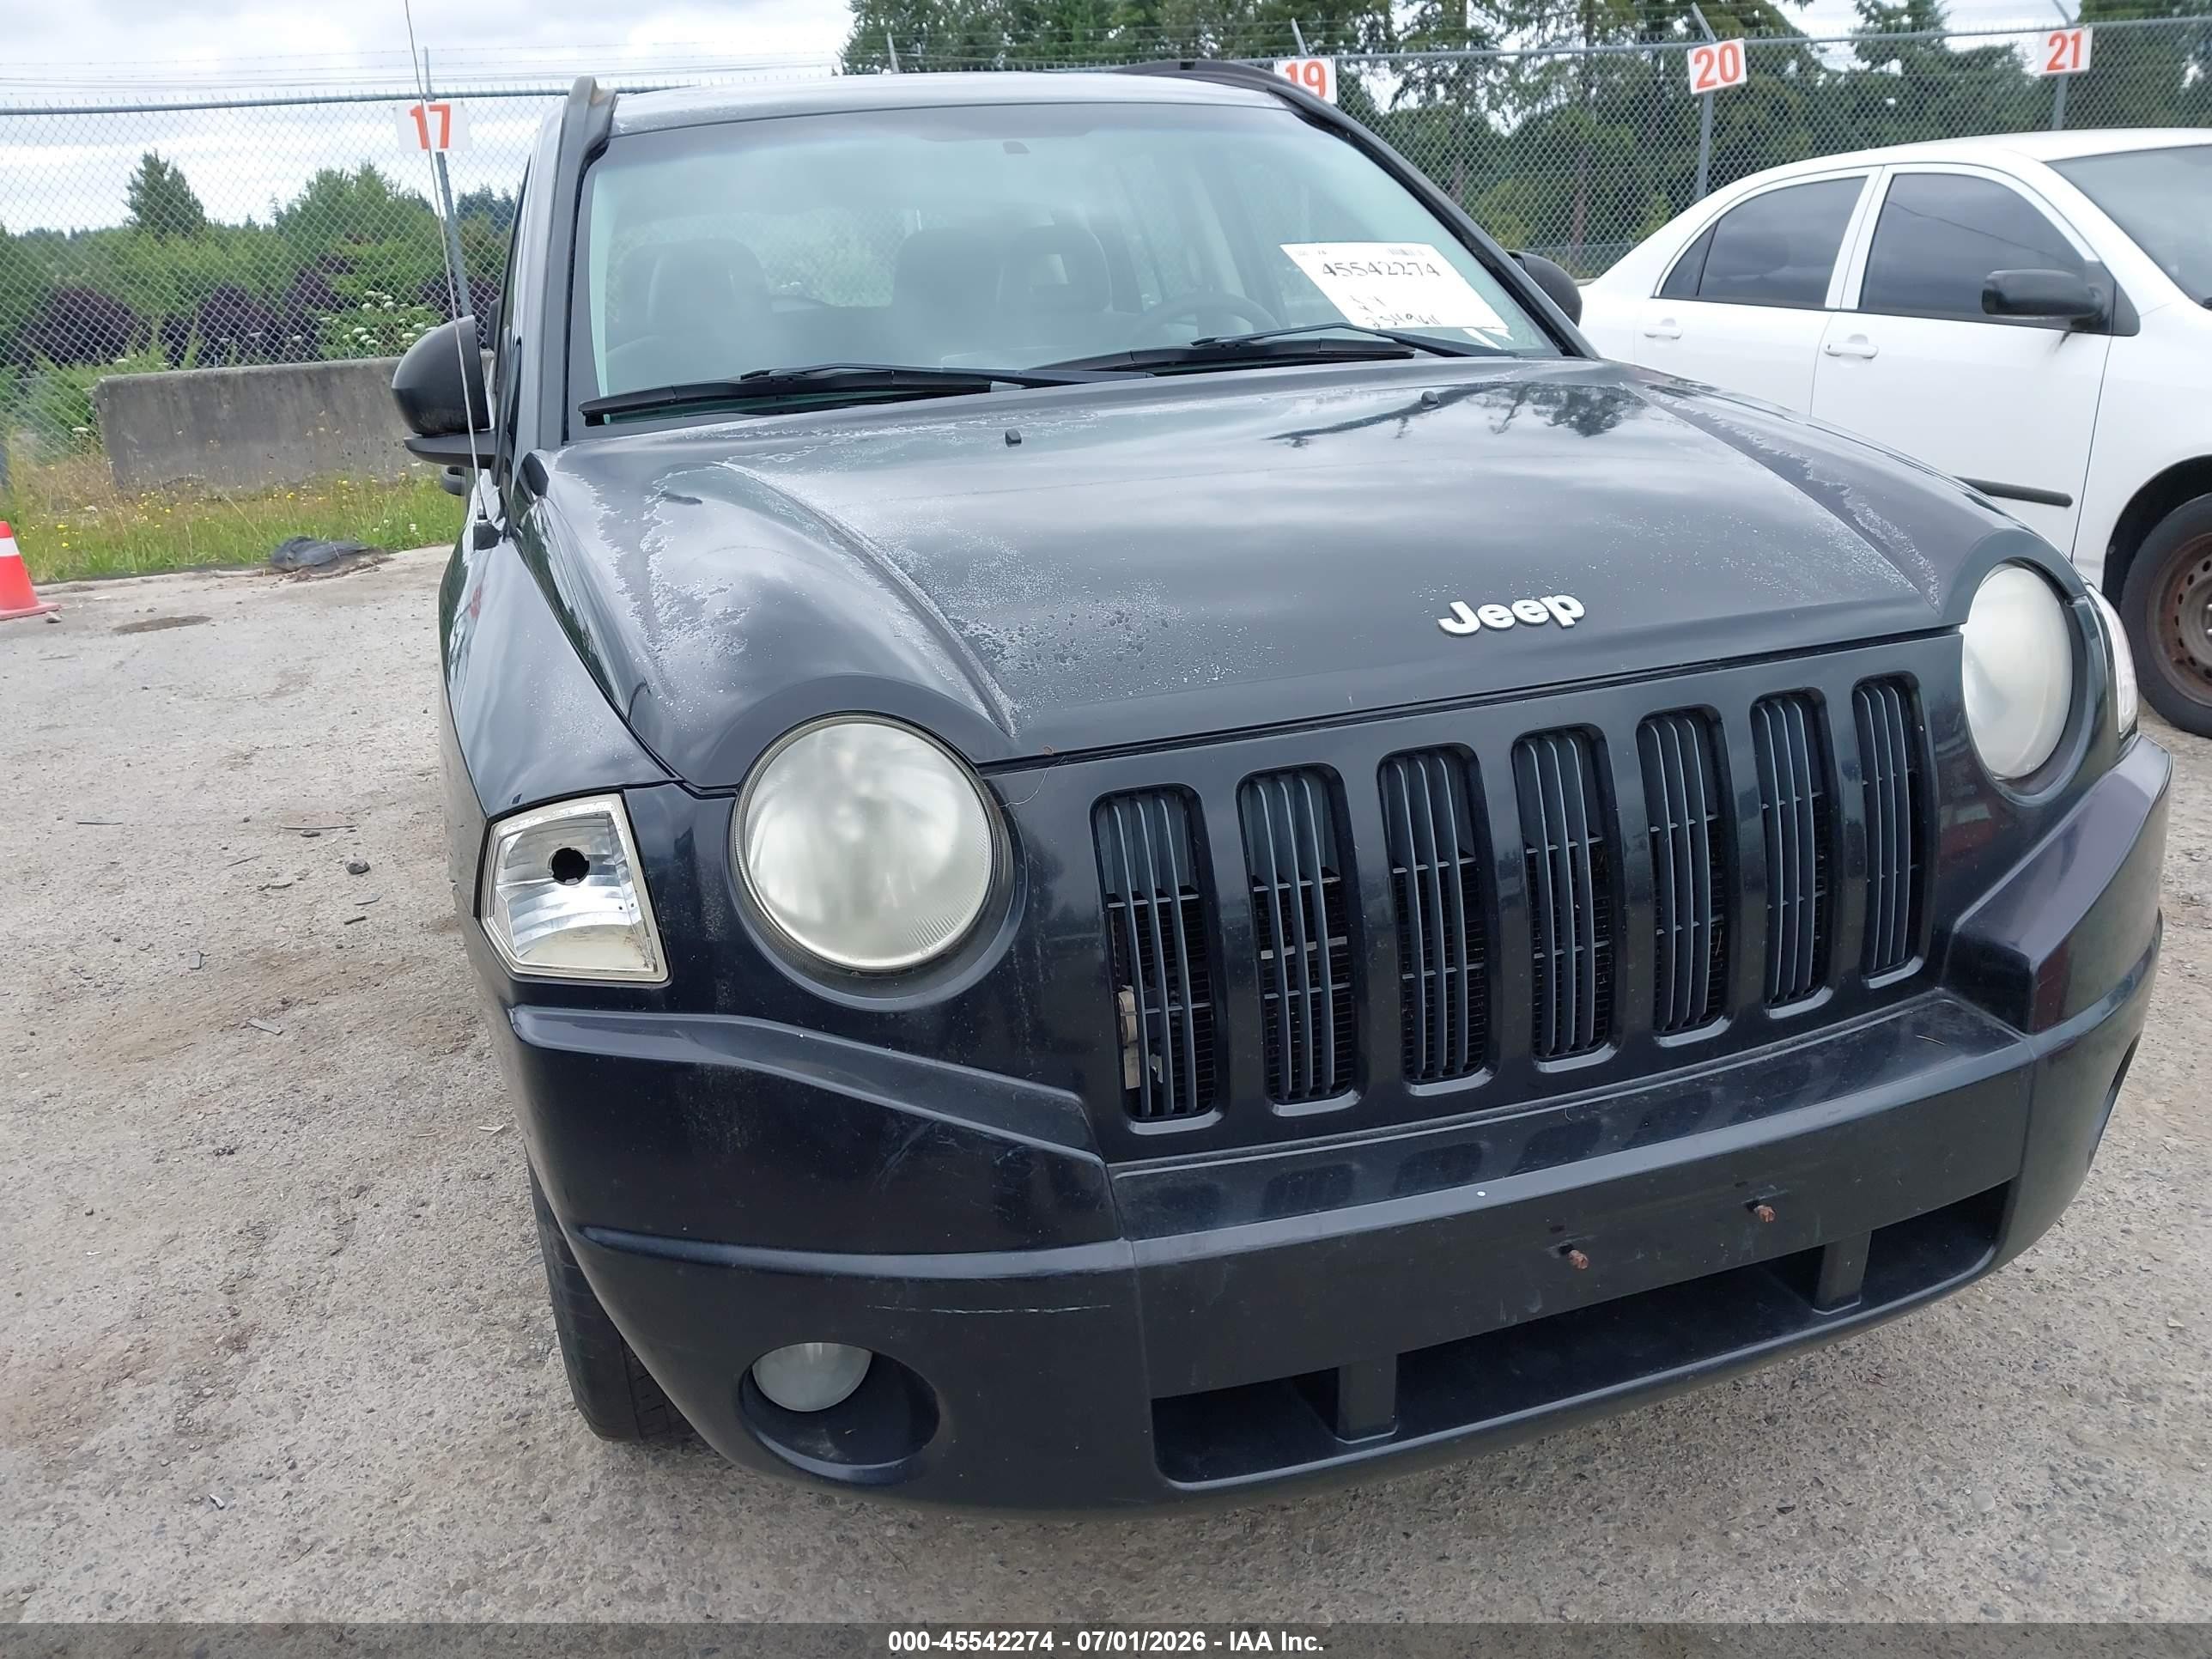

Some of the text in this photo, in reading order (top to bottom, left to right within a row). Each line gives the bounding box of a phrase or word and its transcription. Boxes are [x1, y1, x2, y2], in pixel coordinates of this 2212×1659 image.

[1694, 43, 1740, 89] 20
[2046, 30, 2081, 70] 21
[1285, 61, 1326, 97] 19
[410, 103, 451, 150] 17
[1323, 261, 1440, 276] 45542274
[1437, 594, 1586, 635] Jeep
